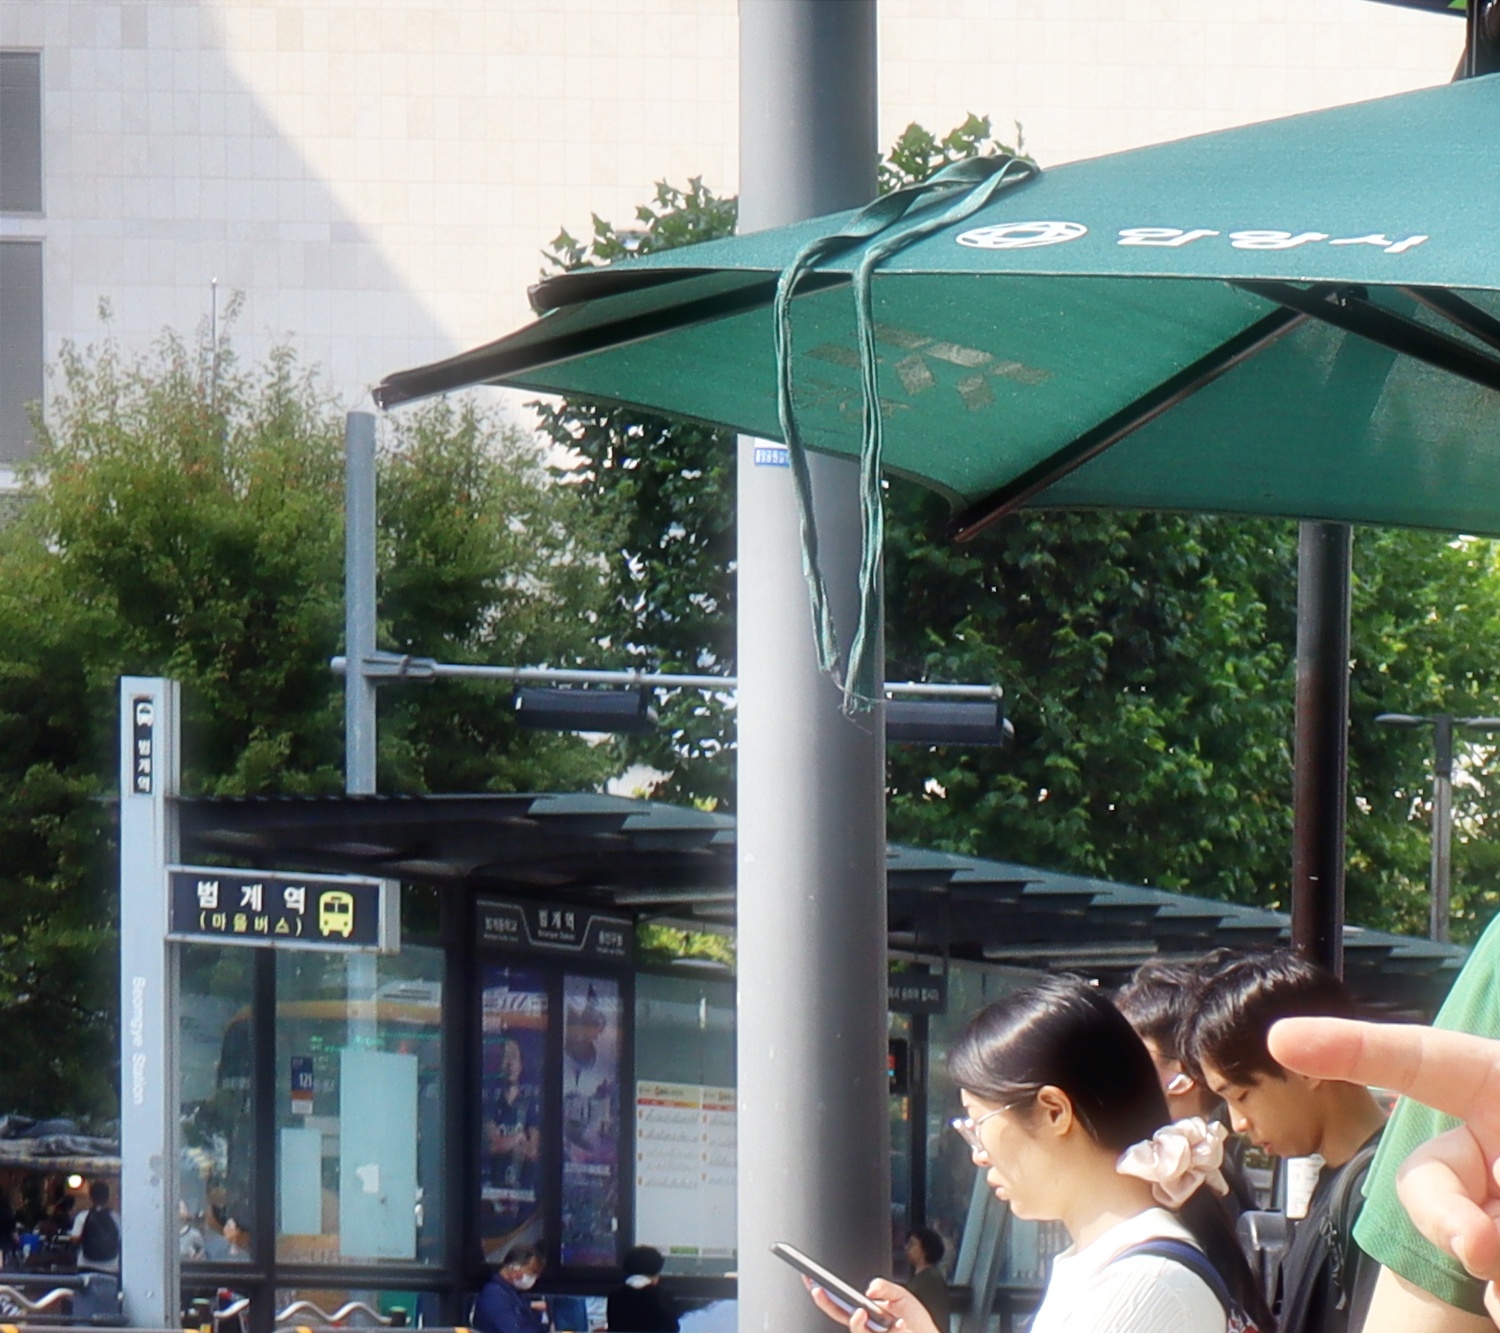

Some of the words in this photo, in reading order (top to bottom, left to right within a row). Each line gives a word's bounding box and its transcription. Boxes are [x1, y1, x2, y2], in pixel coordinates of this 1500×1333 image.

[1117, 227, 1429, 254] 안양시
[197, 880, 306, 915] 범계역
[199, 910, 302, 936] (마을버스)
